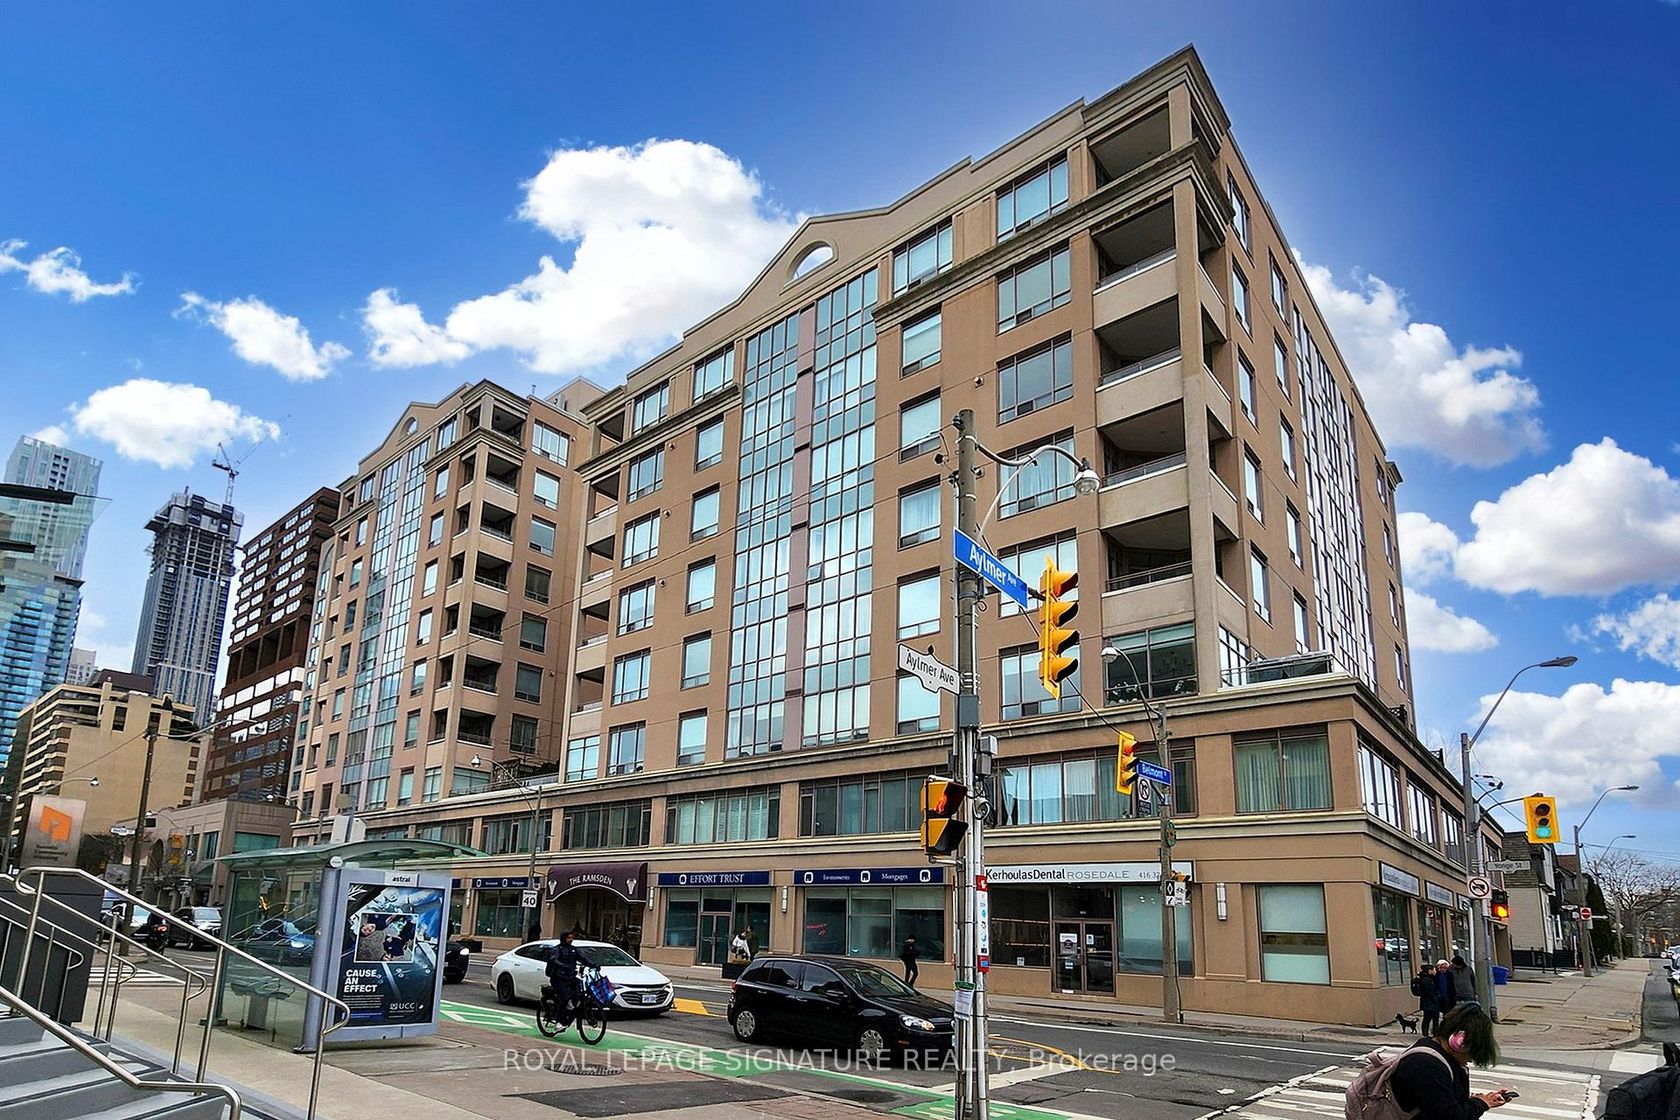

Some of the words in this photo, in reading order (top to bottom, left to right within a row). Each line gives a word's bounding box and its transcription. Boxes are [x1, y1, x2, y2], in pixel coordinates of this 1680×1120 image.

[969, 543, 1007, 586] Aylmer
[1006, 573, 1017, 588] Ave
[906, 652, 938, 678] Aylmer
[939, 668, 955, 686] Ave
[1141, 763, 1164, 780] Belmont
[392, 875, 411, 883] astral
[690, 874, 717, 884] EFFORT
[719, 873, 745, 883] TRUST
[881, 872, 908, 882] Mortgages
[1067, 870, 1130, 879] ROSEDALE
[569, 877, 581, 887] THE
[582, 874, 613, 886] RAMSDEN
[523, 896, 536, 906] 40
[345, 969, 377, 978] CAUSE
[344, 977, 359, 985] AN
[343, 984, 378, 993] EFFECT
[398, 1002, 416, 1010] UCC
